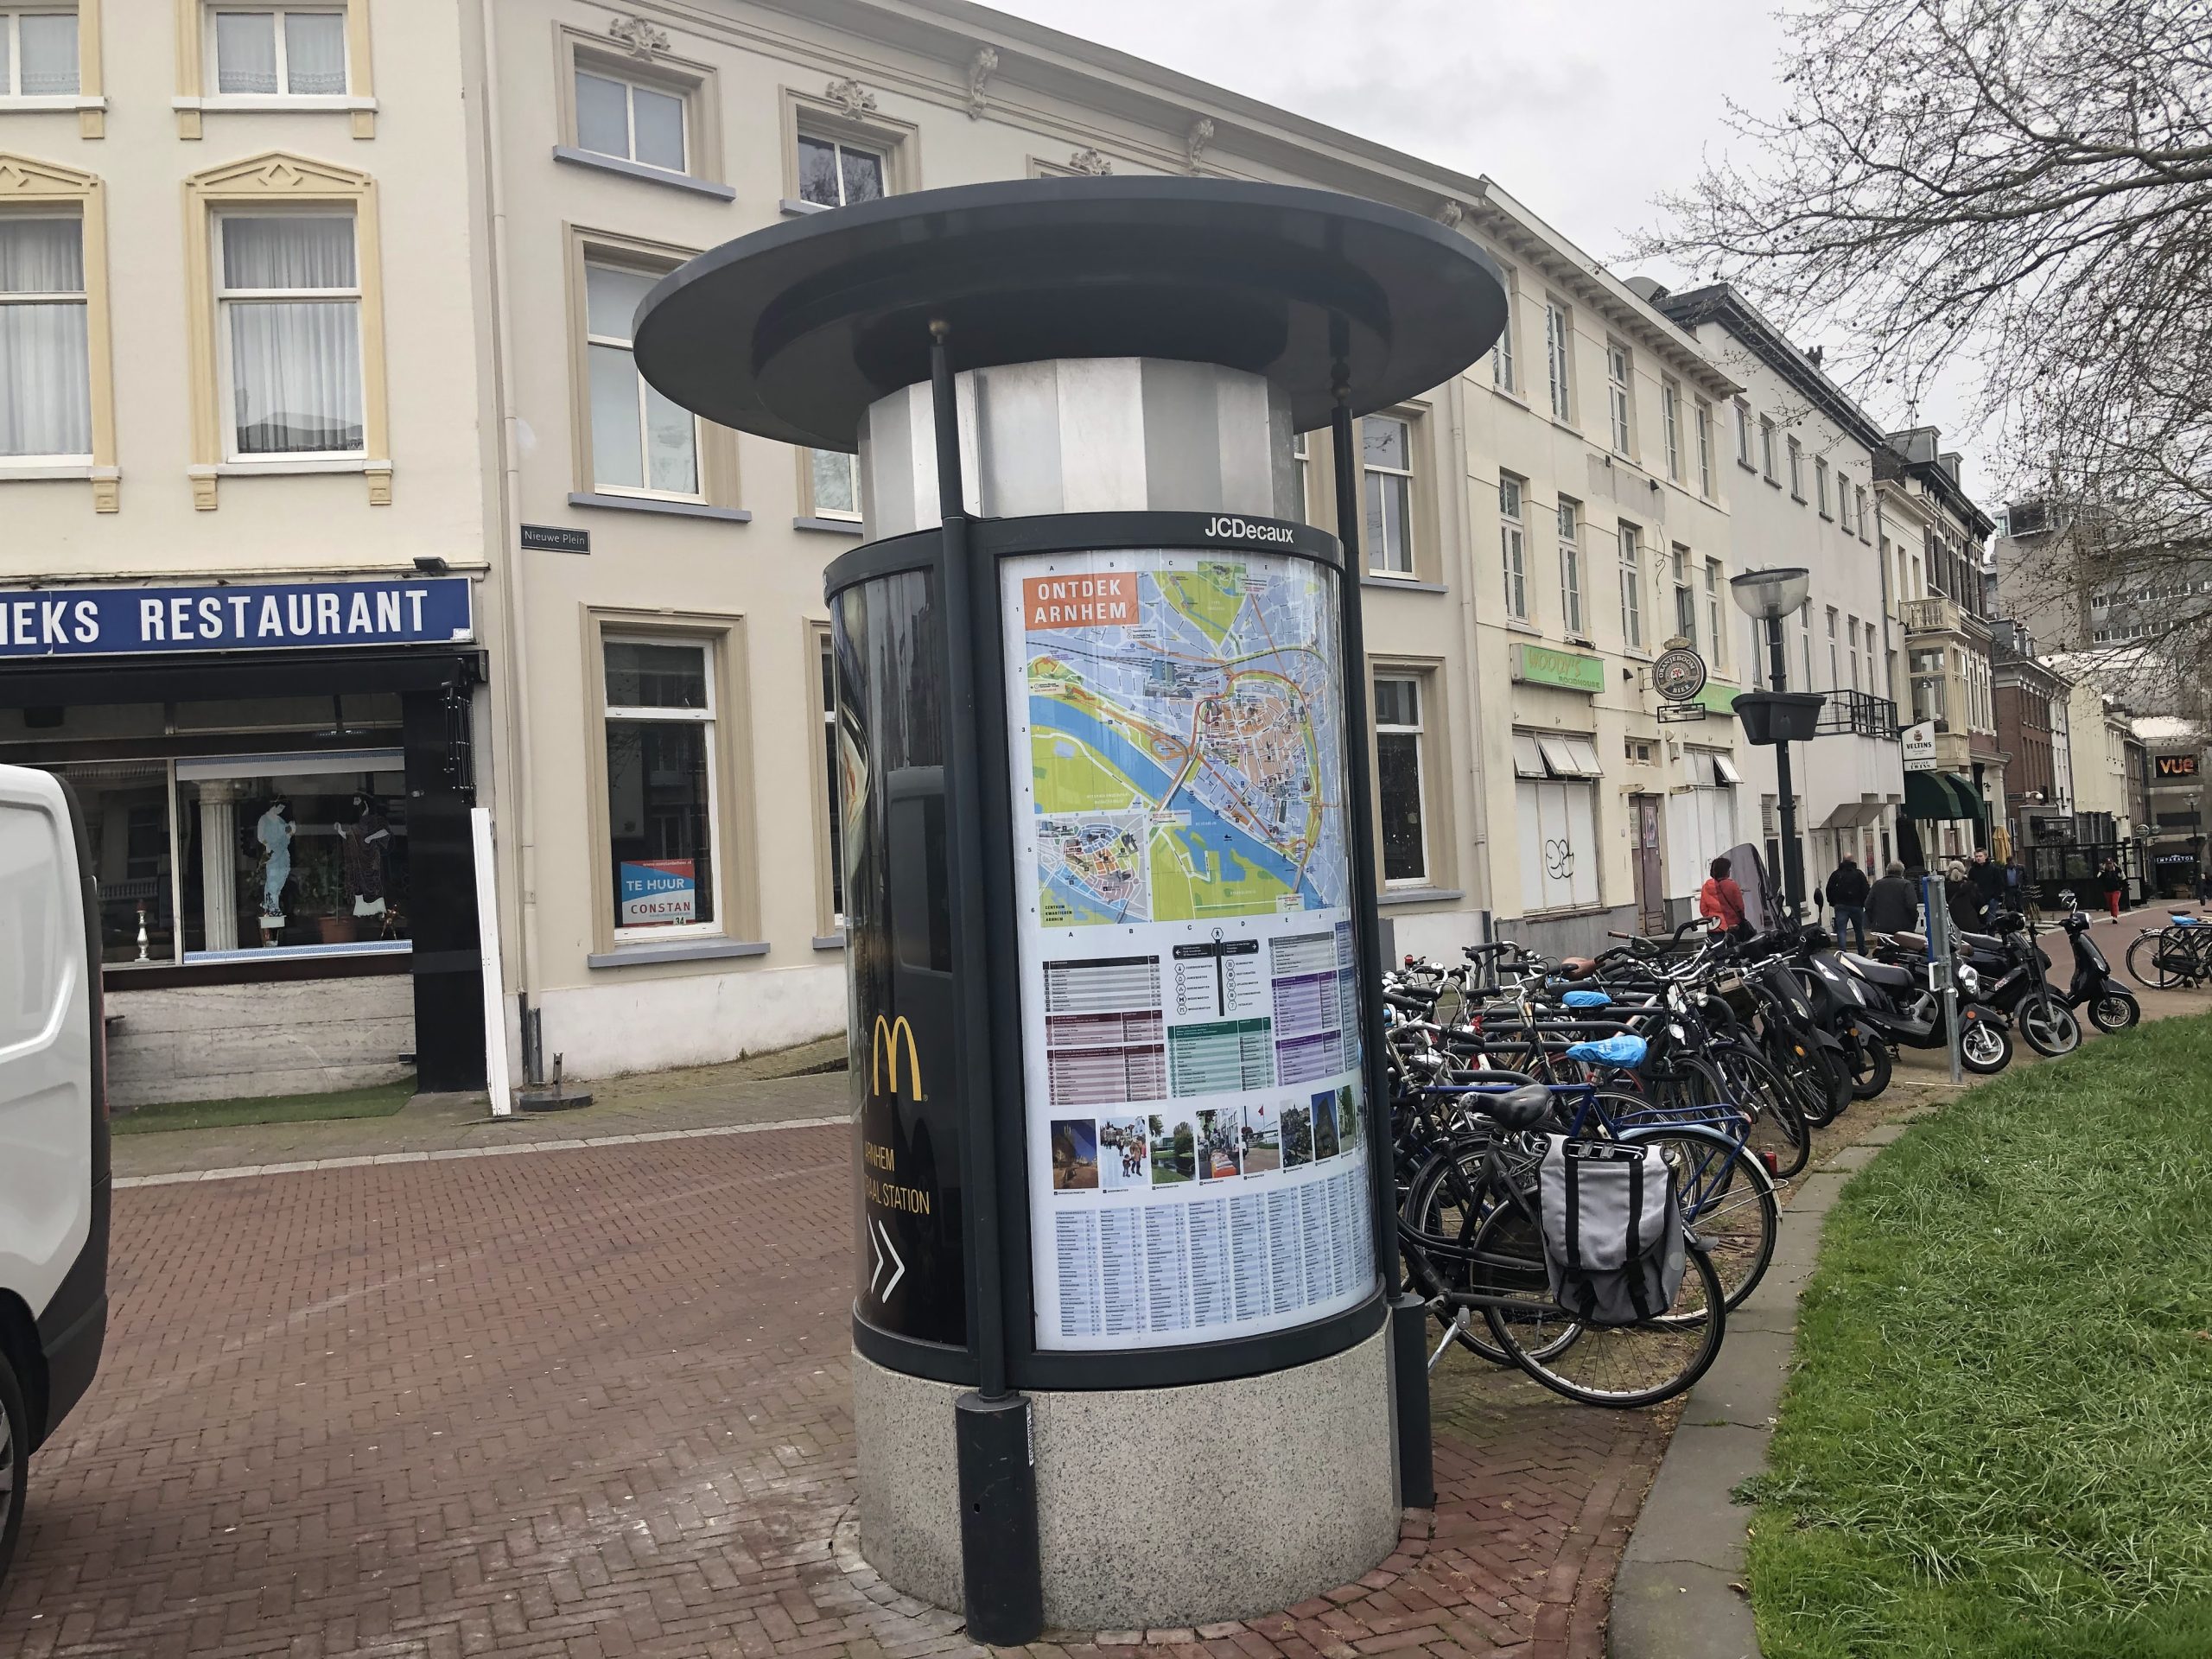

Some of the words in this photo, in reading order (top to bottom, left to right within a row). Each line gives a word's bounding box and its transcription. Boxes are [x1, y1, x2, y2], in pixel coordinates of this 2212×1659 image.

[524, 531, 560, 543] Nieuwe
[563, 534, 585, 544] Plein
[1205, 517, 1294, 543] JCDecaux
[1038, 579, 1122, 601] ONTDEK
[140, 590, 428, 641] RESTAURANT
[1034, 602, 1127, 624] ARNHEM
[1658, 655, 1695, 678] ORANJEBOOM
[1672, 684, 1691, 694] BIER
[626, 880, 643, 891] TE
[647, 879, 684, 890] HUUR
[631, 901, 690, 914] CONSTAN
[882, 1183, 930, 1215] STATION
